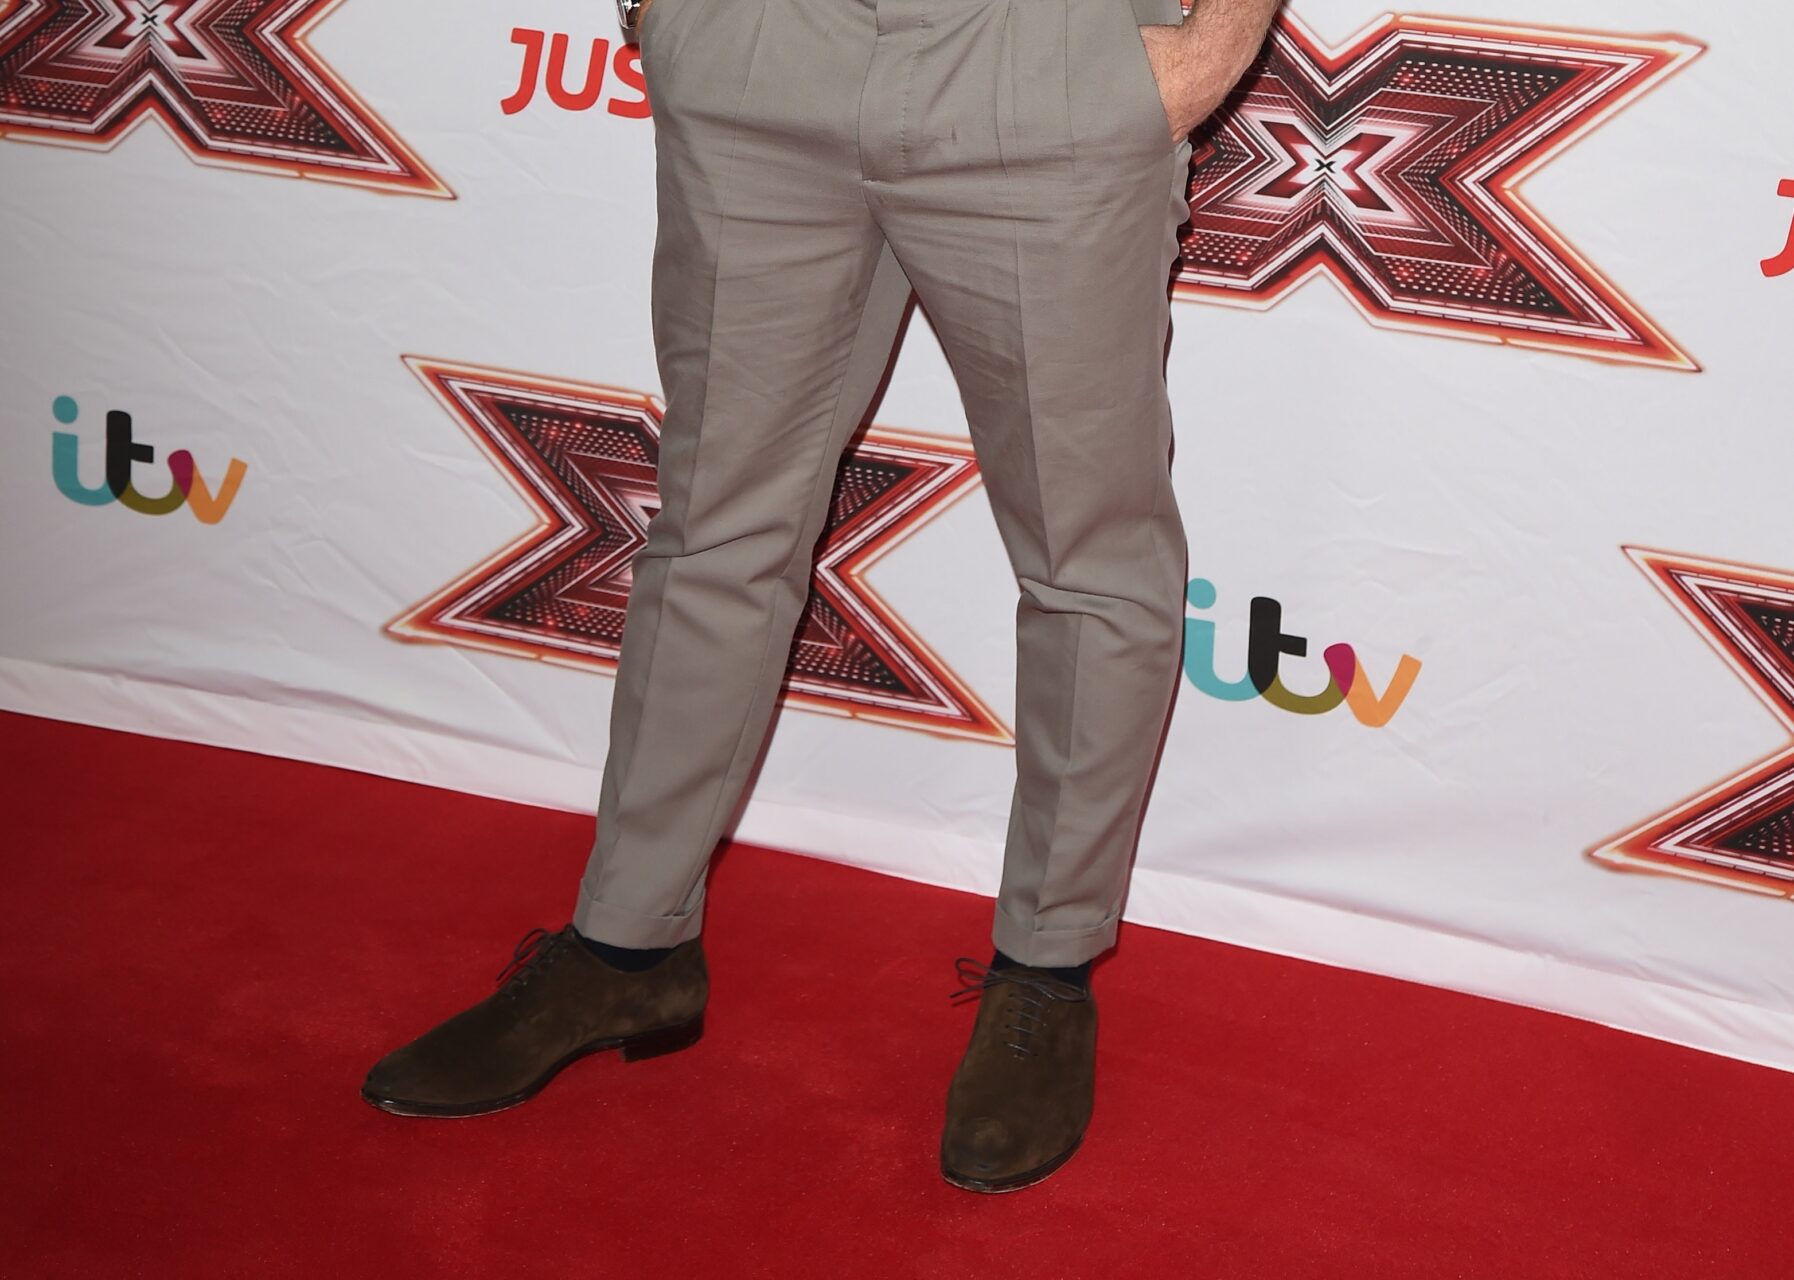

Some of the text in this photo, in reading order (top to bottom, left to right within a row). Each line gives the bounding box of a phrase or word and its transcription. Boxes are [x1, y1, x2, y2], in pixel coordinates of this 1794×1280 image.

[500, 27, 652, 119] JUS
[52, 395, 248, 525] itv
[1184, 578, 1422, 728] itv
